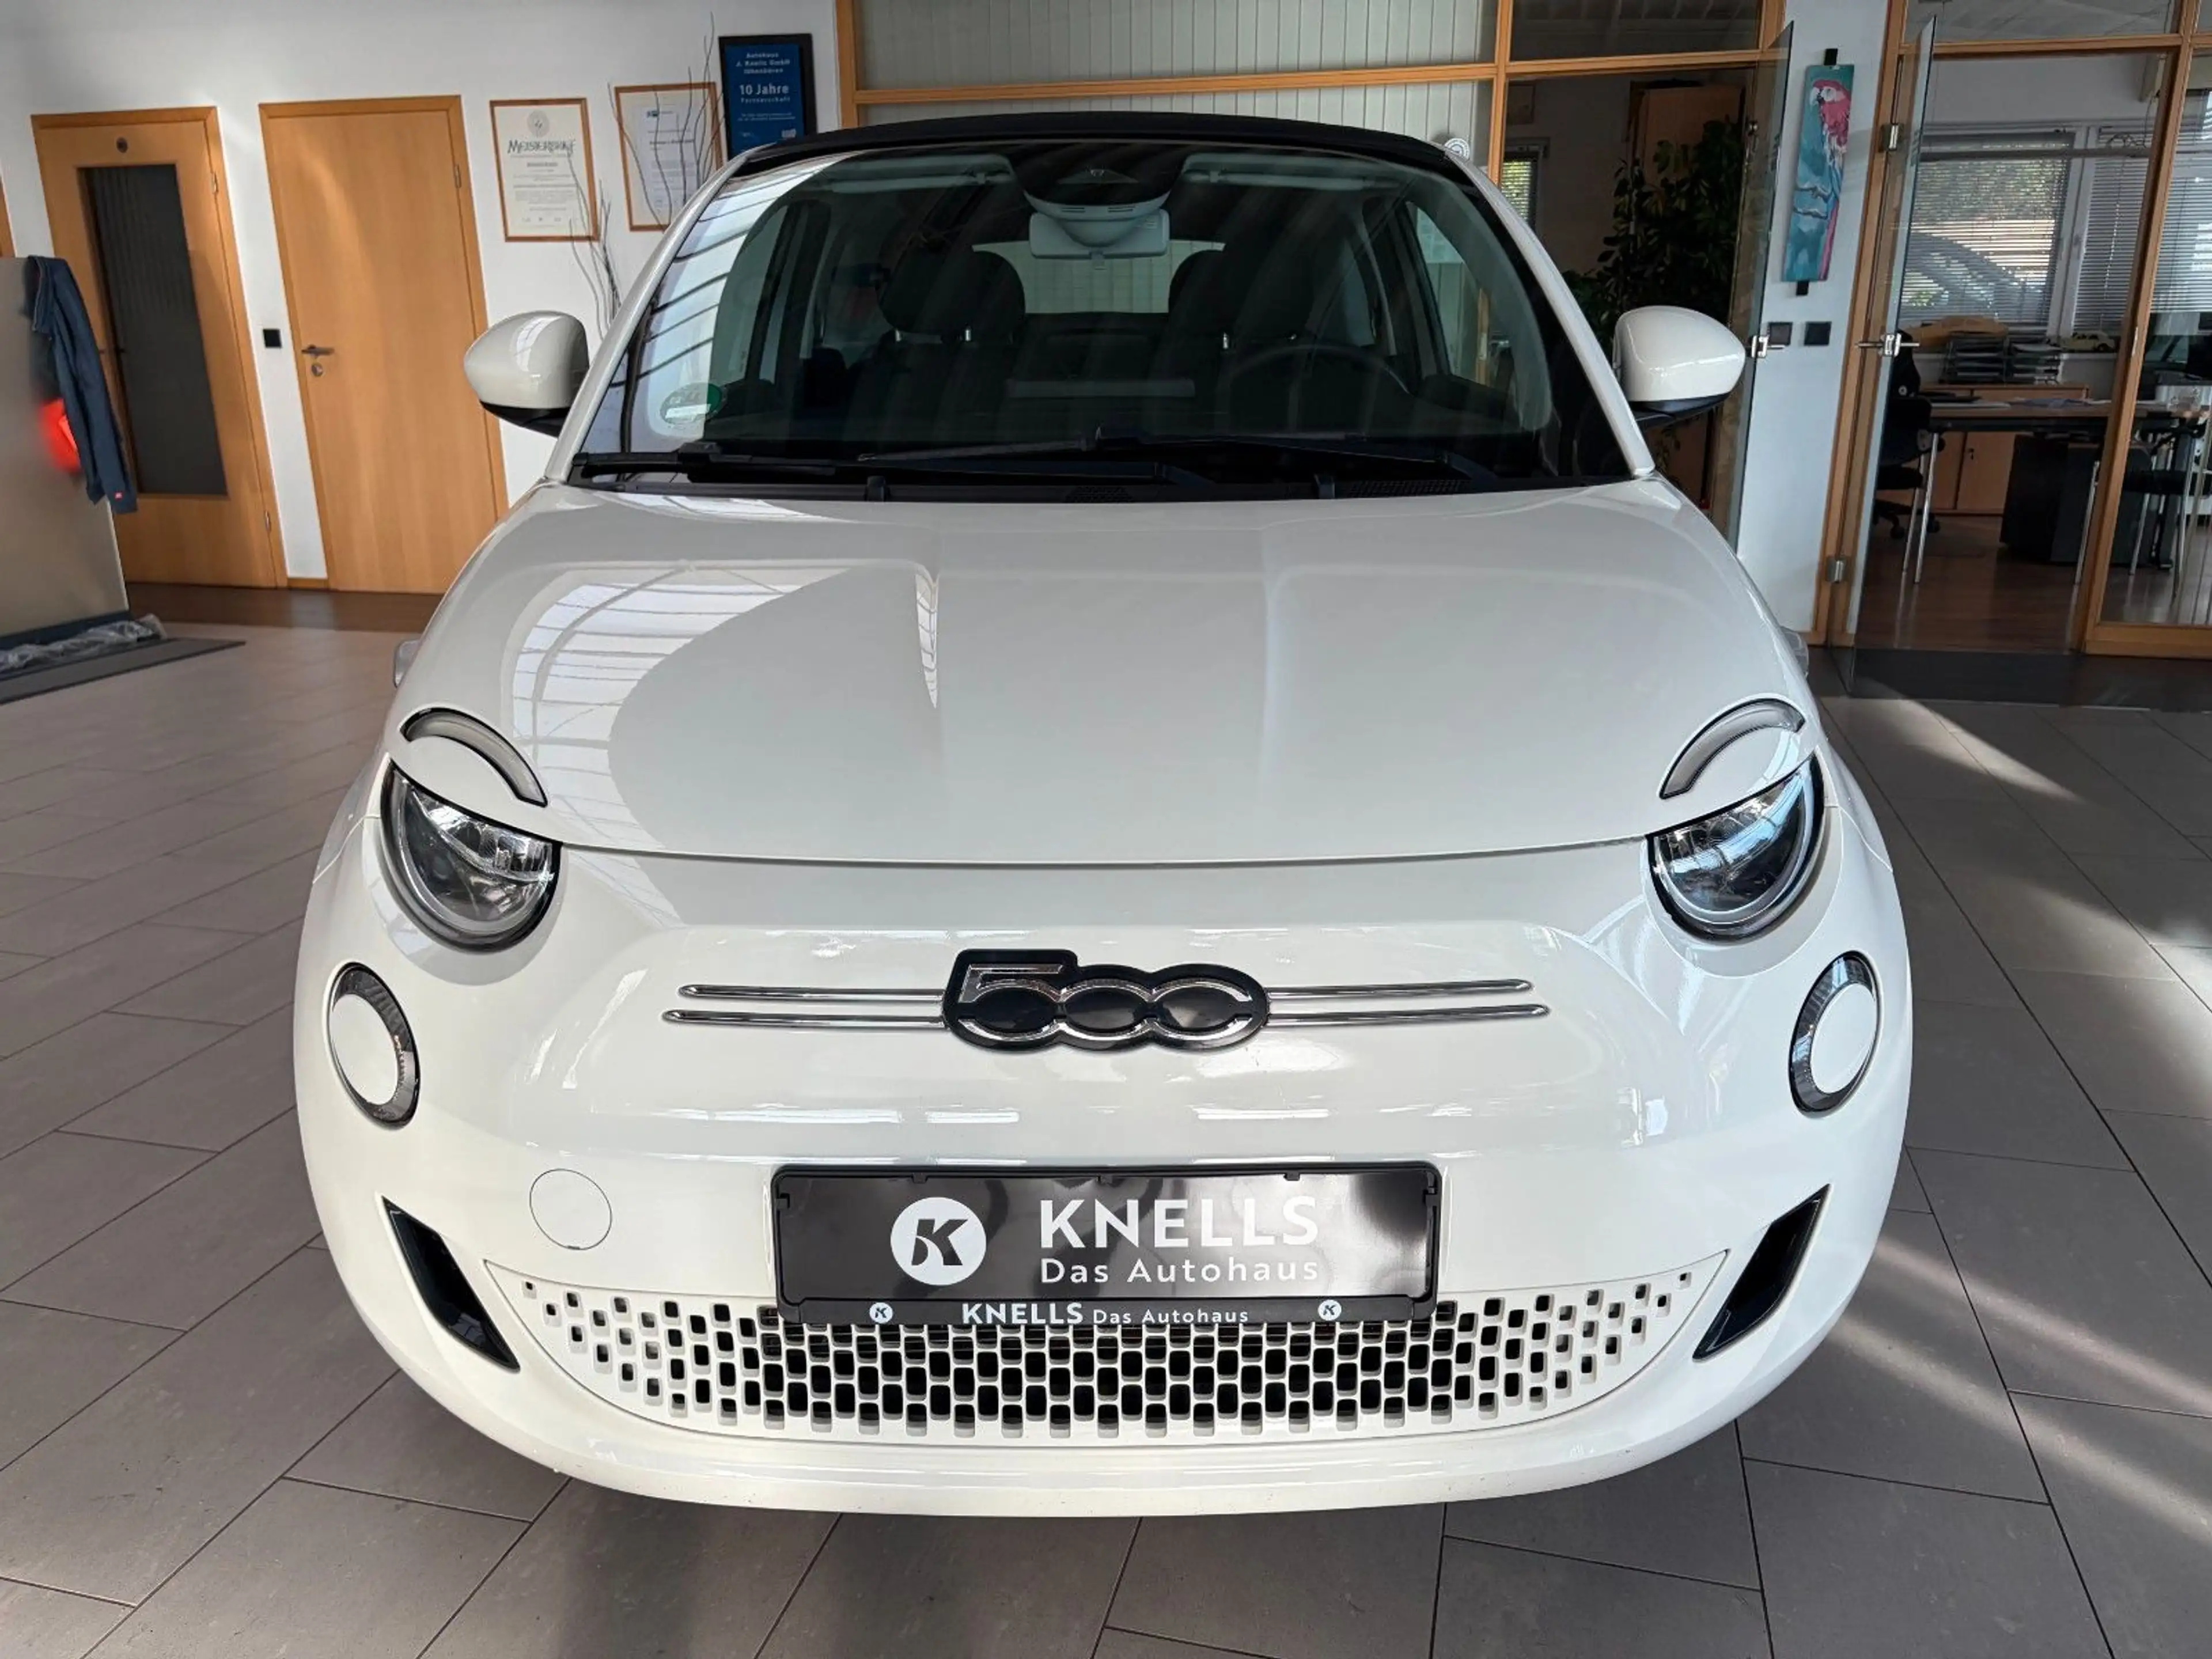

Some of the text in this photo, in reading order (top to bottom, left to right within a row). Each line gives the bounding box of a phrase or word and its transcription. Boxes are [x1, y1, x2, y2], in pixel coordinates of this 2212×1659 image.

[739, 83, 789, 95] 10 Jahre
[954, 961, 1256, 1041] 500
[1040, 1195, 1319, 1248] KNELLS
[1041, 1256, 1319, 1283] Das Autohaus
[962, 1302, 1249, 1324] KNELLS Das Autohaus
